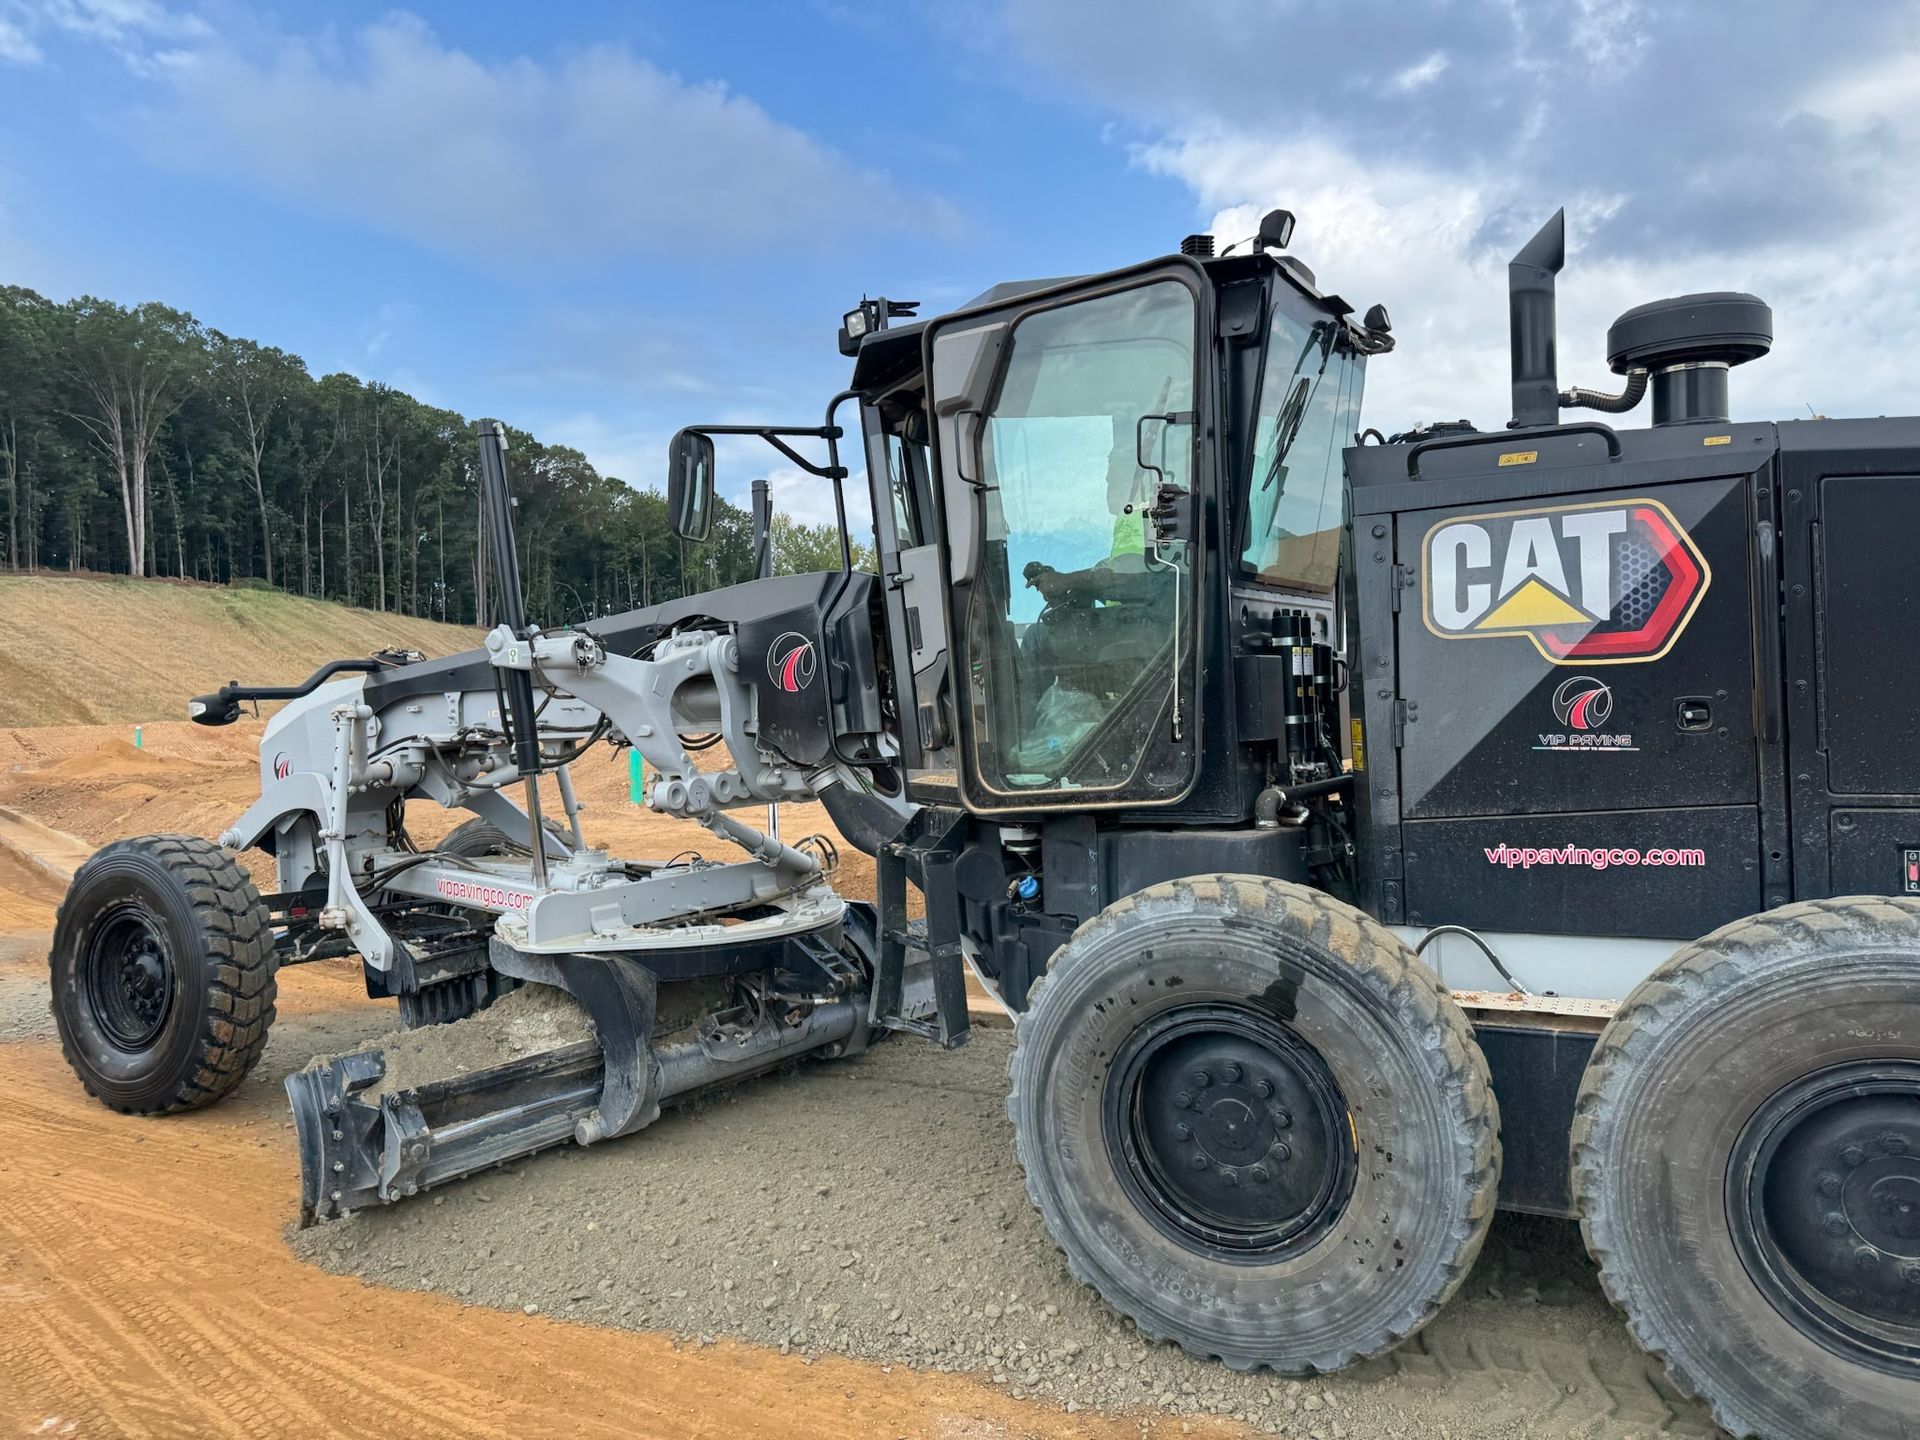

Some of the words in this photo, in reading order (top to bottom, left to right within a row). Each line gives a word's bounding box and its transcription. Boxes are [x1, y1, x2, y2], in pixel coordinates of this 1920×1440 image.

[1431, 510, 1626, 630] CAT
[1538, 734, 1566, 745] VIP
[1569, 735, 1632, 747] PAVING
[1484, 843, 1705, 870] vippavingco.com
